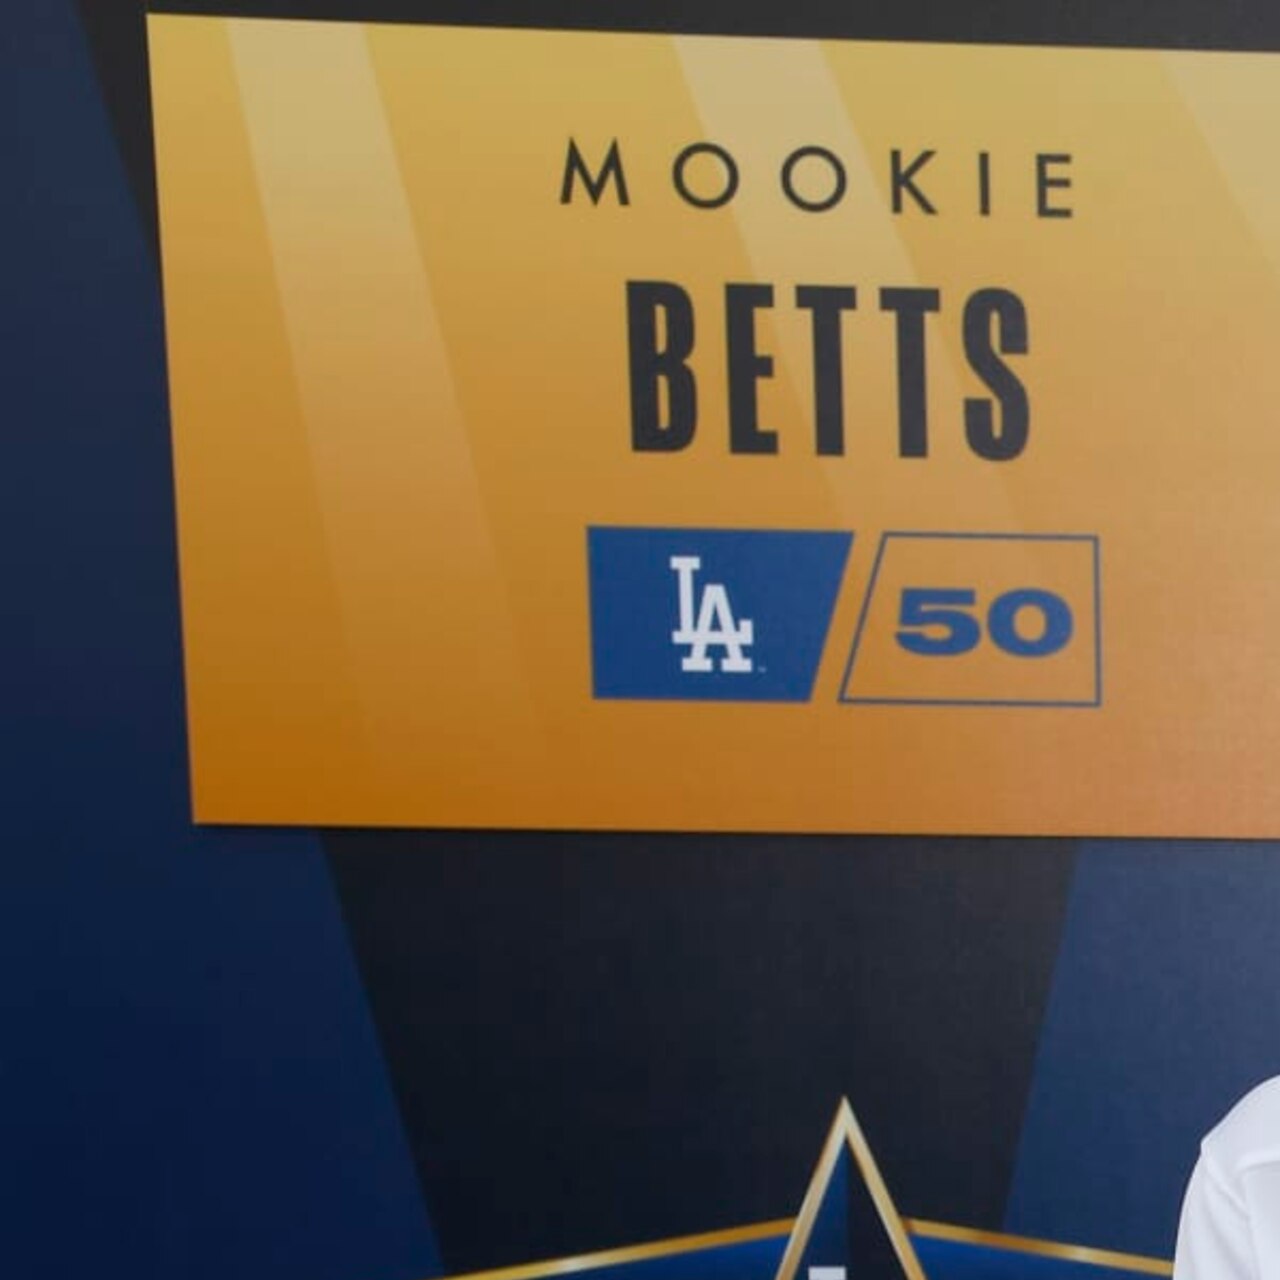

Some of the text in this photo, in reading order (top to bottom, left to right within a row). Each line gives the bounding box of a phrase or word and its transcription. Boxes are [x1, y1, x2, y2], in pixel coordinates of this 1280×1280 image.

[559, 135, 1074, 219] MOOKIE
[625, 279, 1031, 463] BETTS
[669, 555, 755, 673] LA
[893, 587, 1074, 659] 50
